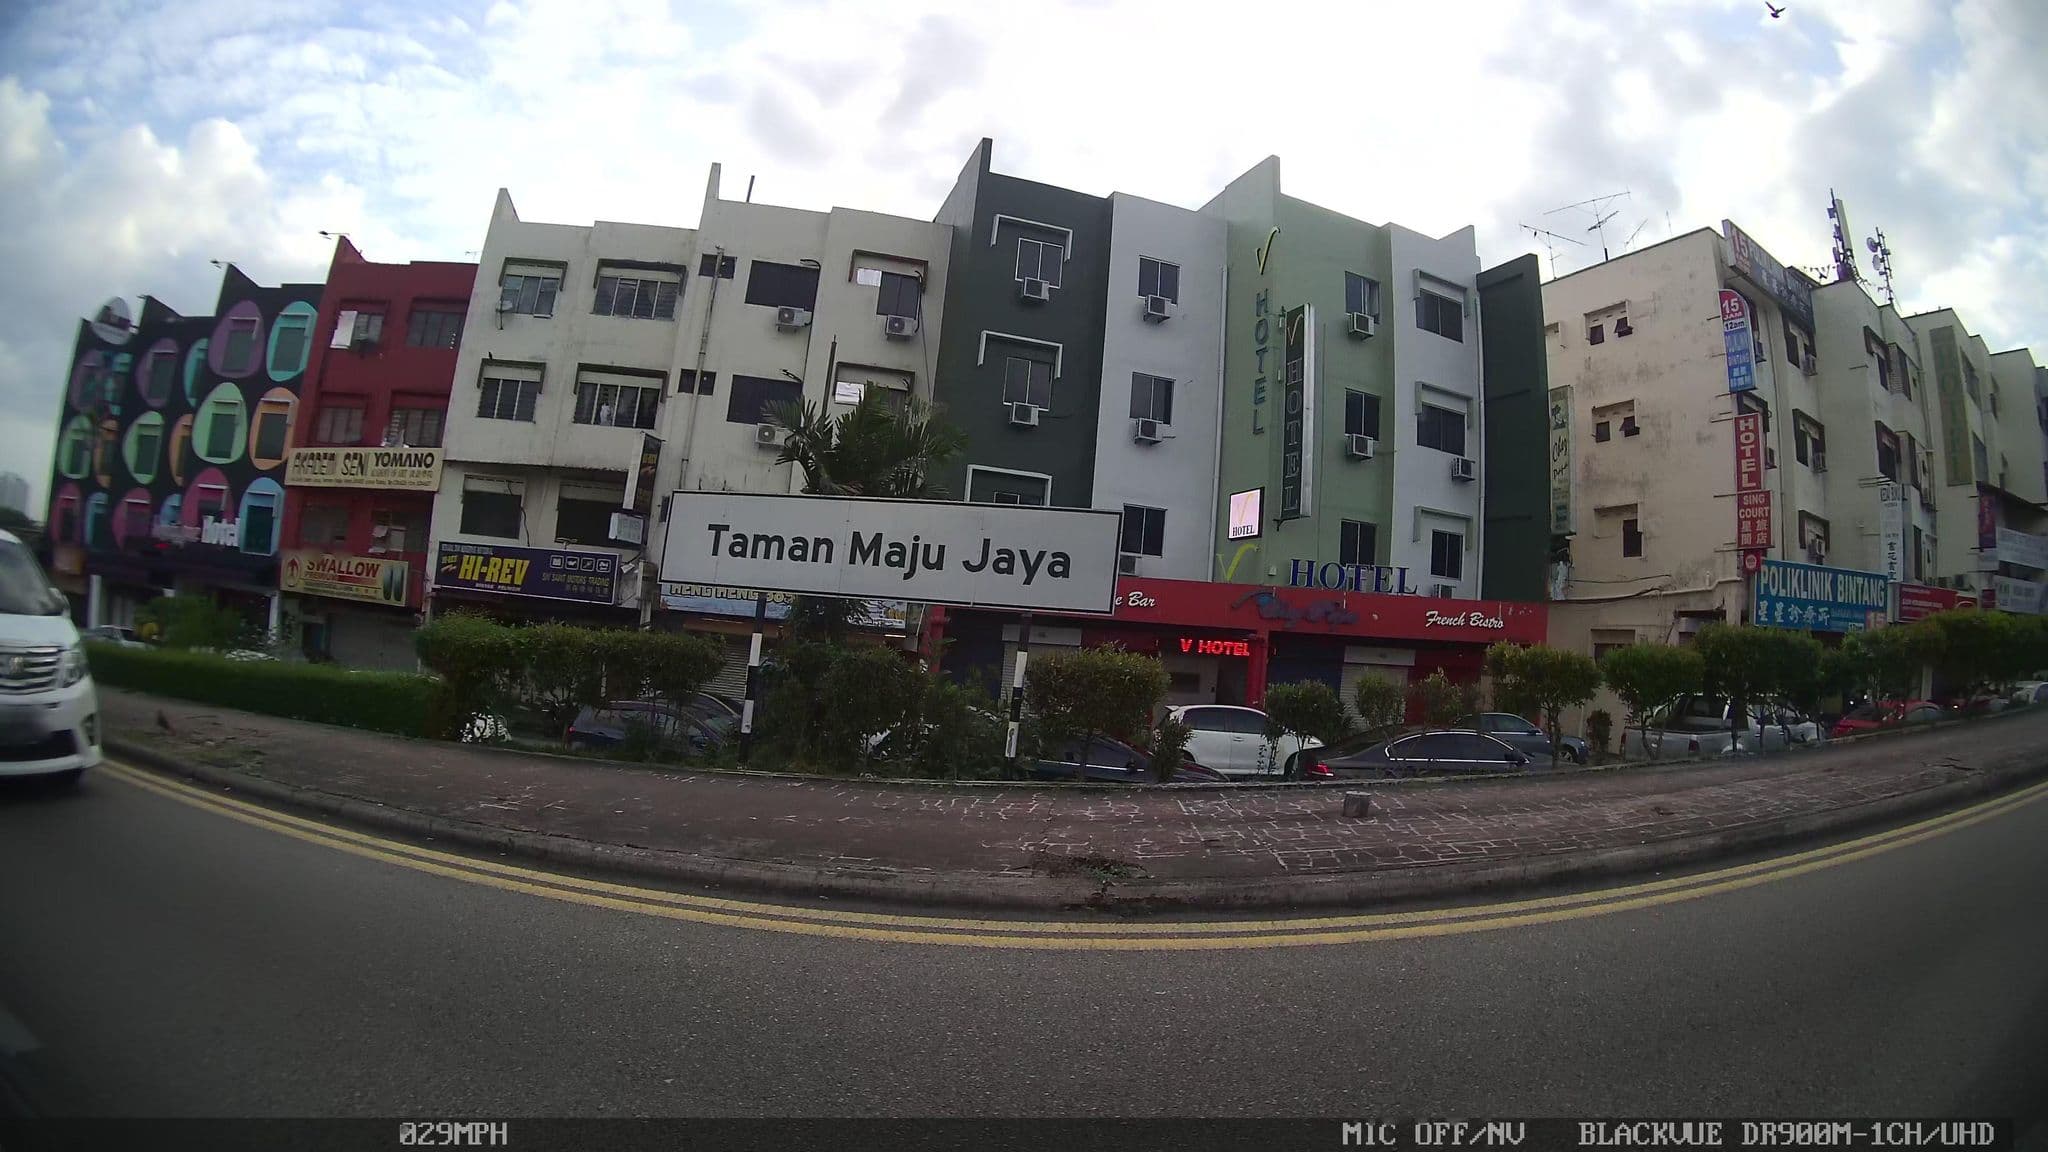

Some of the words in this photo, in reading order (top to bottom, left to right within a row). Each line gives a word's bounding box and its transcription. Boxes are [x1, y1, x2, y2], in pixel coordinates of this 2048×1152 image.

[1722, 298, 1740, 313] 15
[1723, 311, 1743, 321] JAM
[1253, 288, 1269, 435] HOTEL
[1285, 358, 1303, 511] HOTEL
[374, 452, 435, 469] YOMANO
[1739, 418, 1756, 488] HOTEL
[1743, 494, 1765, 505] SING
[1739, 506, 1769, 519] COURT
[1232, 525, 1255, 537] HOTEL
[708, 523, 834, 564] Taman
[848, 531, 947, 581] Maju
[962, 538, 1071, 586] Jaya
[306, 558, 381, 578] SWALLOW
[458, 554, 530, 587] HI-REV
[1289, 558, 1418, 594] HOTEL
[1760, 565, 1833, 602] POLIKLINIK
[1837, 574, 1885, 608] BINTANG
[1128, 591, 1156, 607] Bar
[1425, 610, 1466, 628] French
[1469, 612, 1504, 629] Bistro
[1180, 638, 1193, 652] V
[1198, 639, 1250, 657] HOTEL
